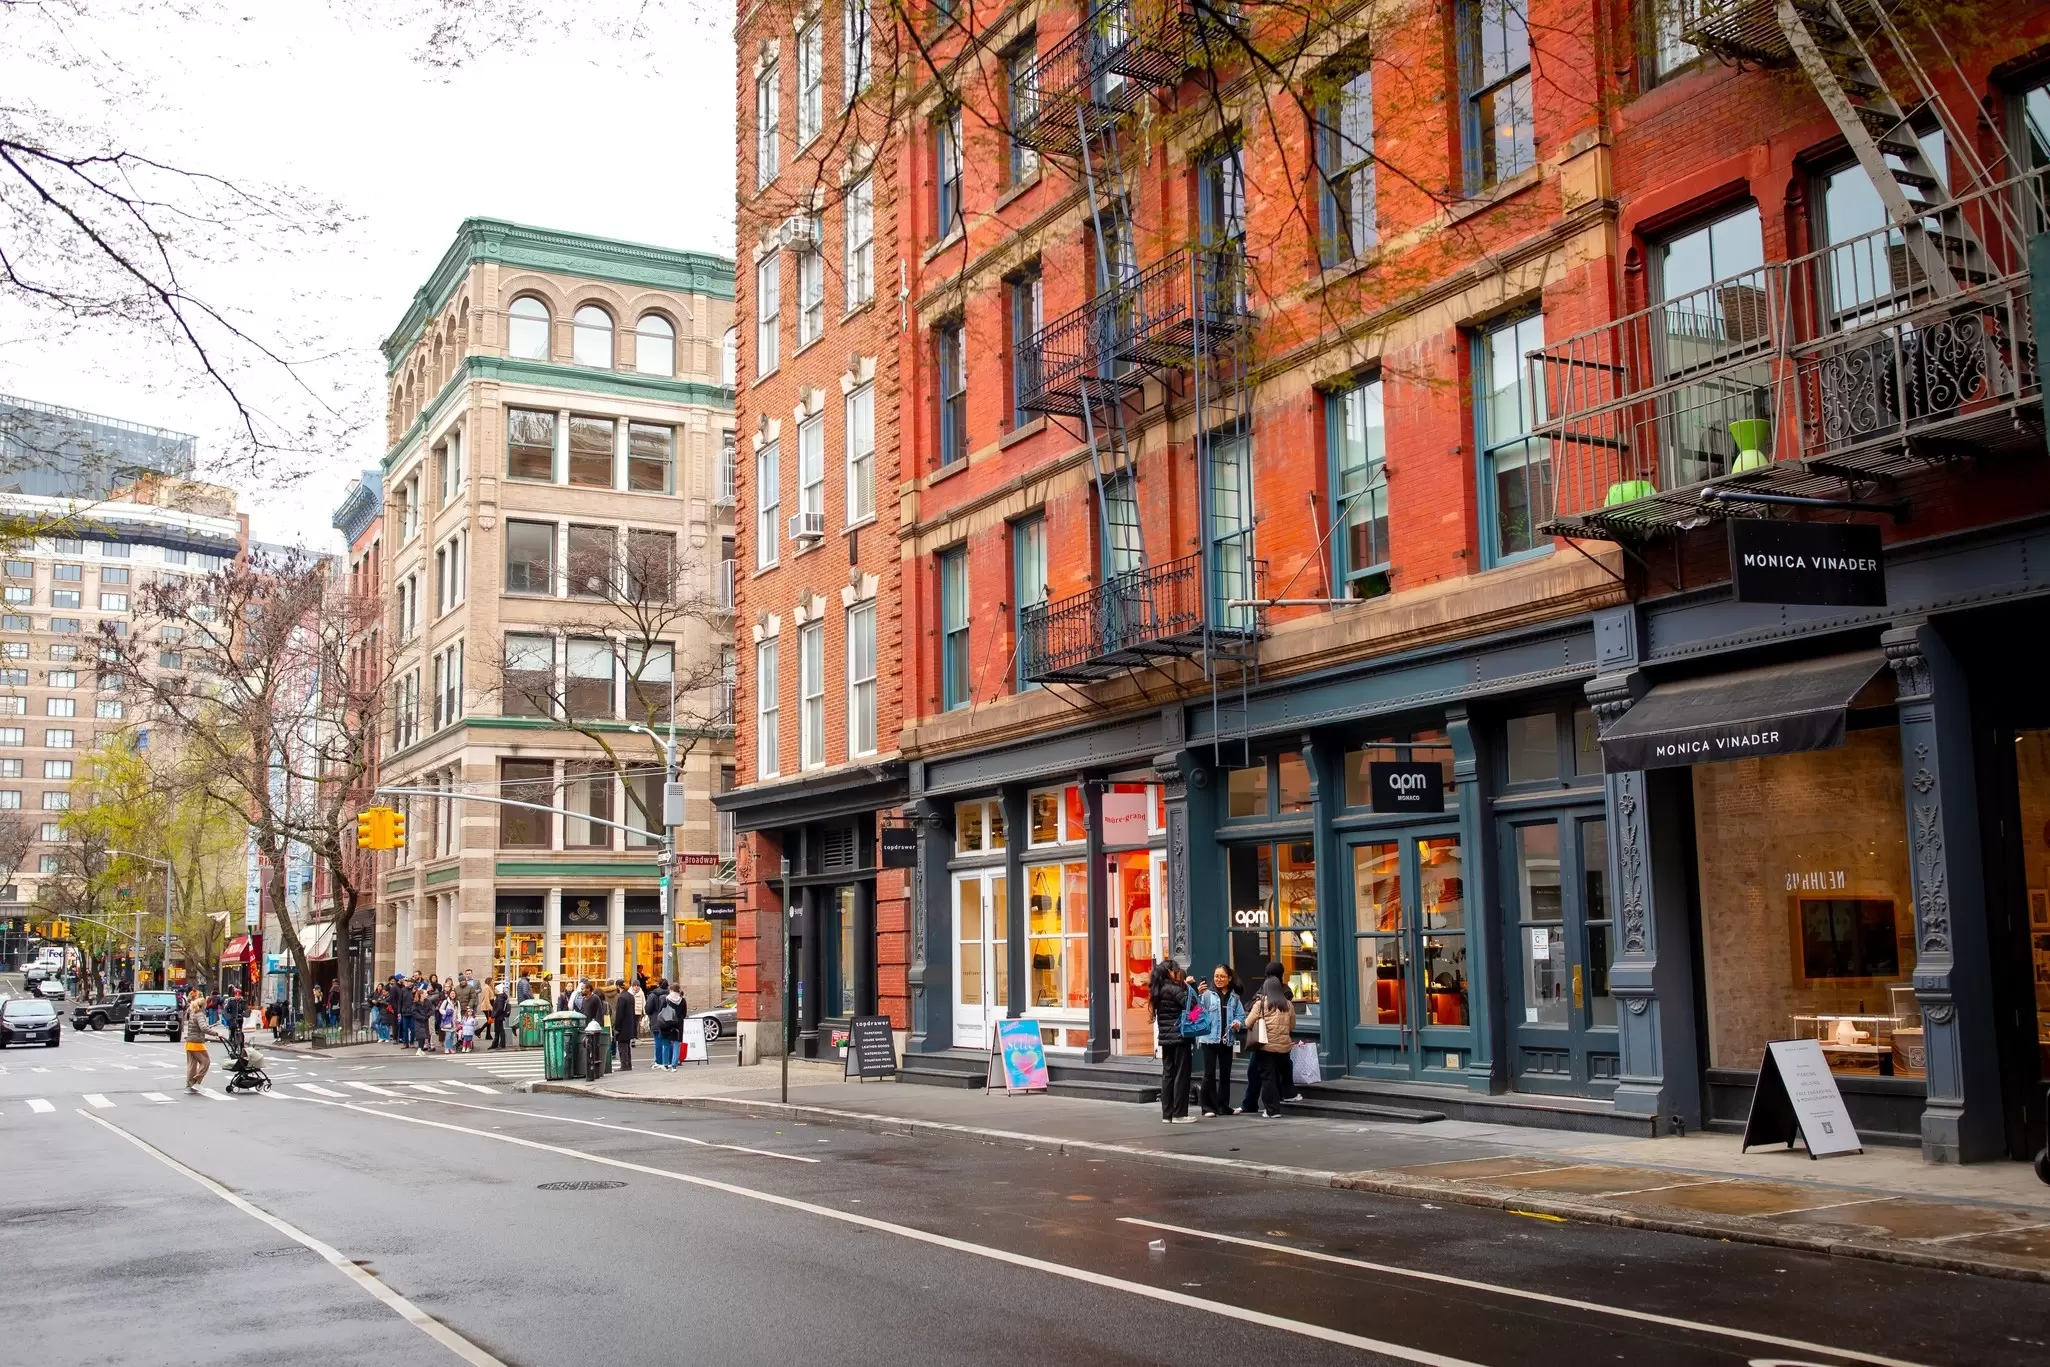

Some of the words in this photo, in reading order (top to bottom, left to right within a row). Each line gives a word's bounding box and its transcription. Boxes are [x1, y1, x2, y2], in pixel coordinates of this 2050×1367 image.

[1744, 553, 1806, 569] MONICA
[1812, 556, 1877, 571] VINADER
[1656, 742, 1710, 757] MONICA
[1716, 731, 1779, 749] VINADER
[1389, 773, 1426, 795] apm
[685, 855, 717, 865] Broadway
[1235, 910, 1268, 928] apm
[49, 949, 76, 958] Fedx
